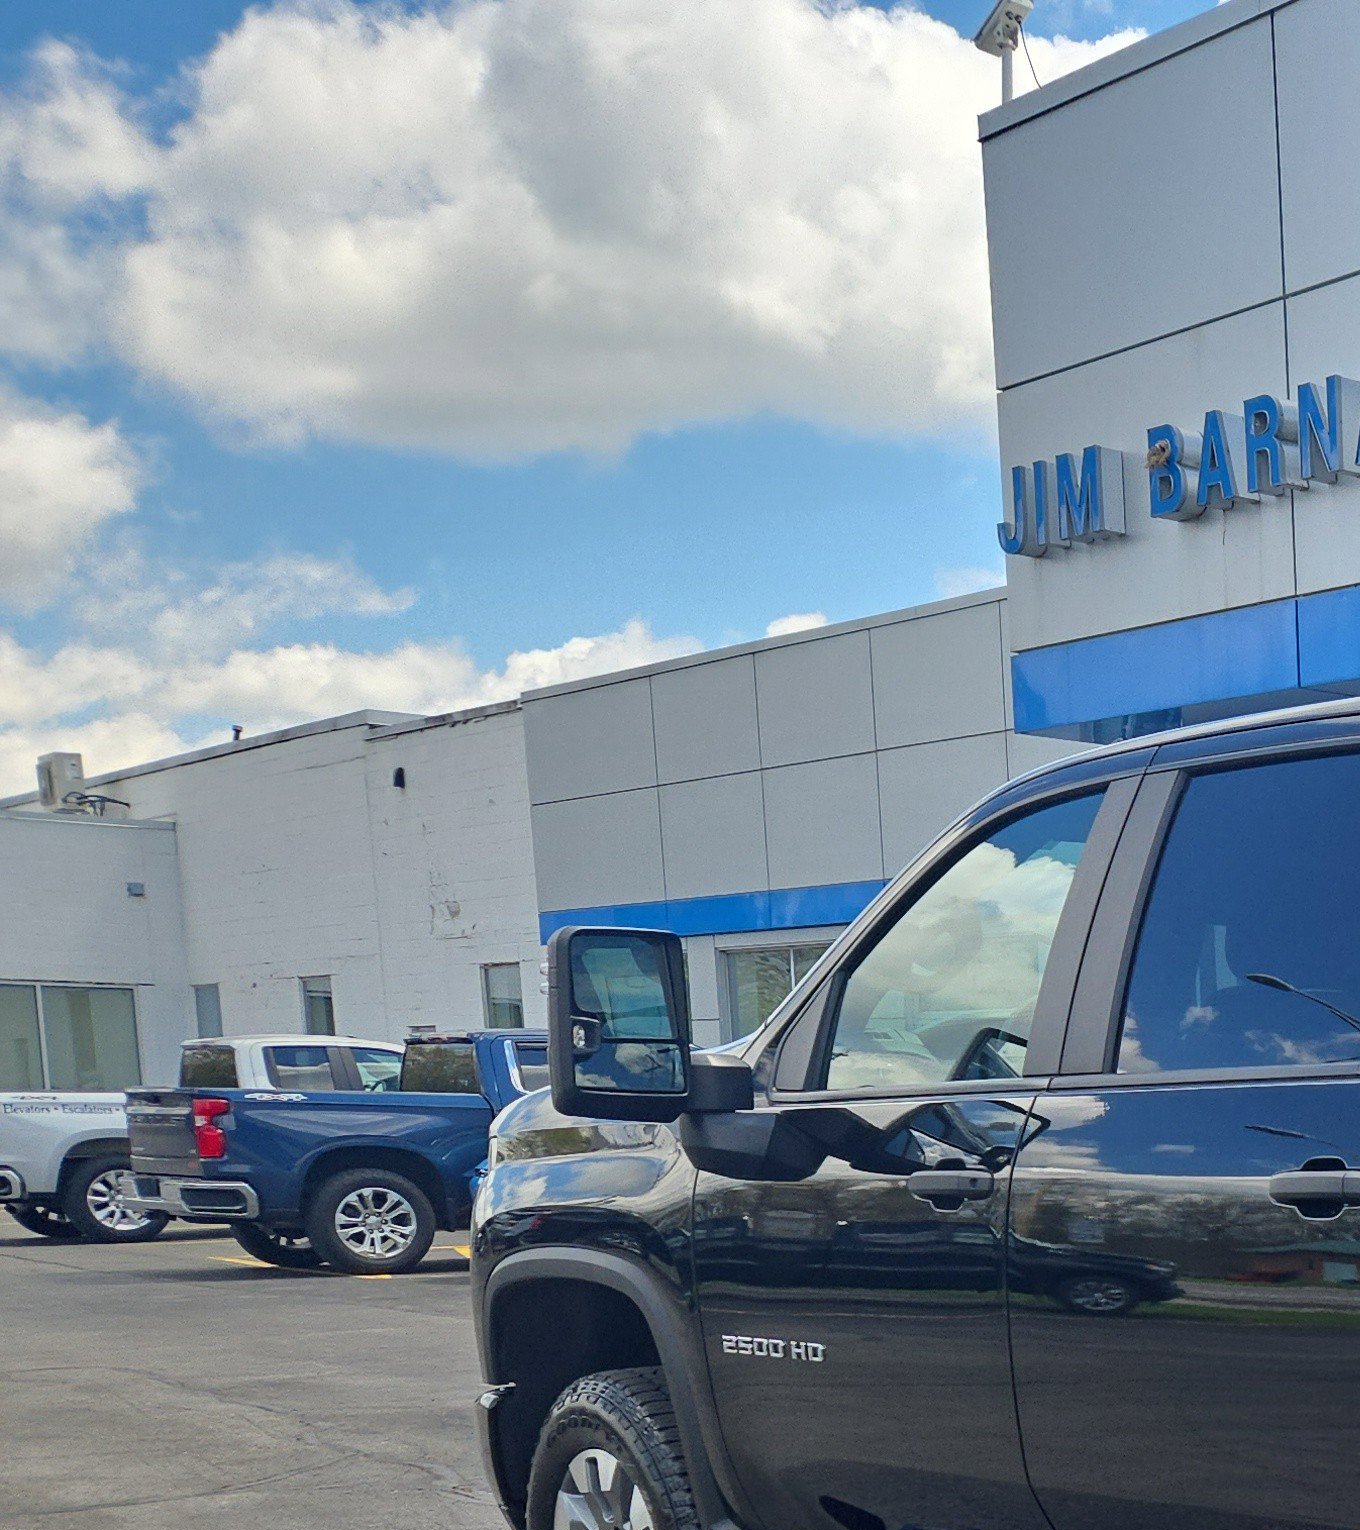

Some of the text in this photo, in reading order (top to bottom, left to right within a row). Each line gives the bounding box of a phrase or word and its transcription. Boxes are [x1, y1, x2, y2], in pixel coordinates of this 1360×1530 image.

[997, 444, 1105, 557] JIM
[722, 1335, 827, 1362] 2500 HD
